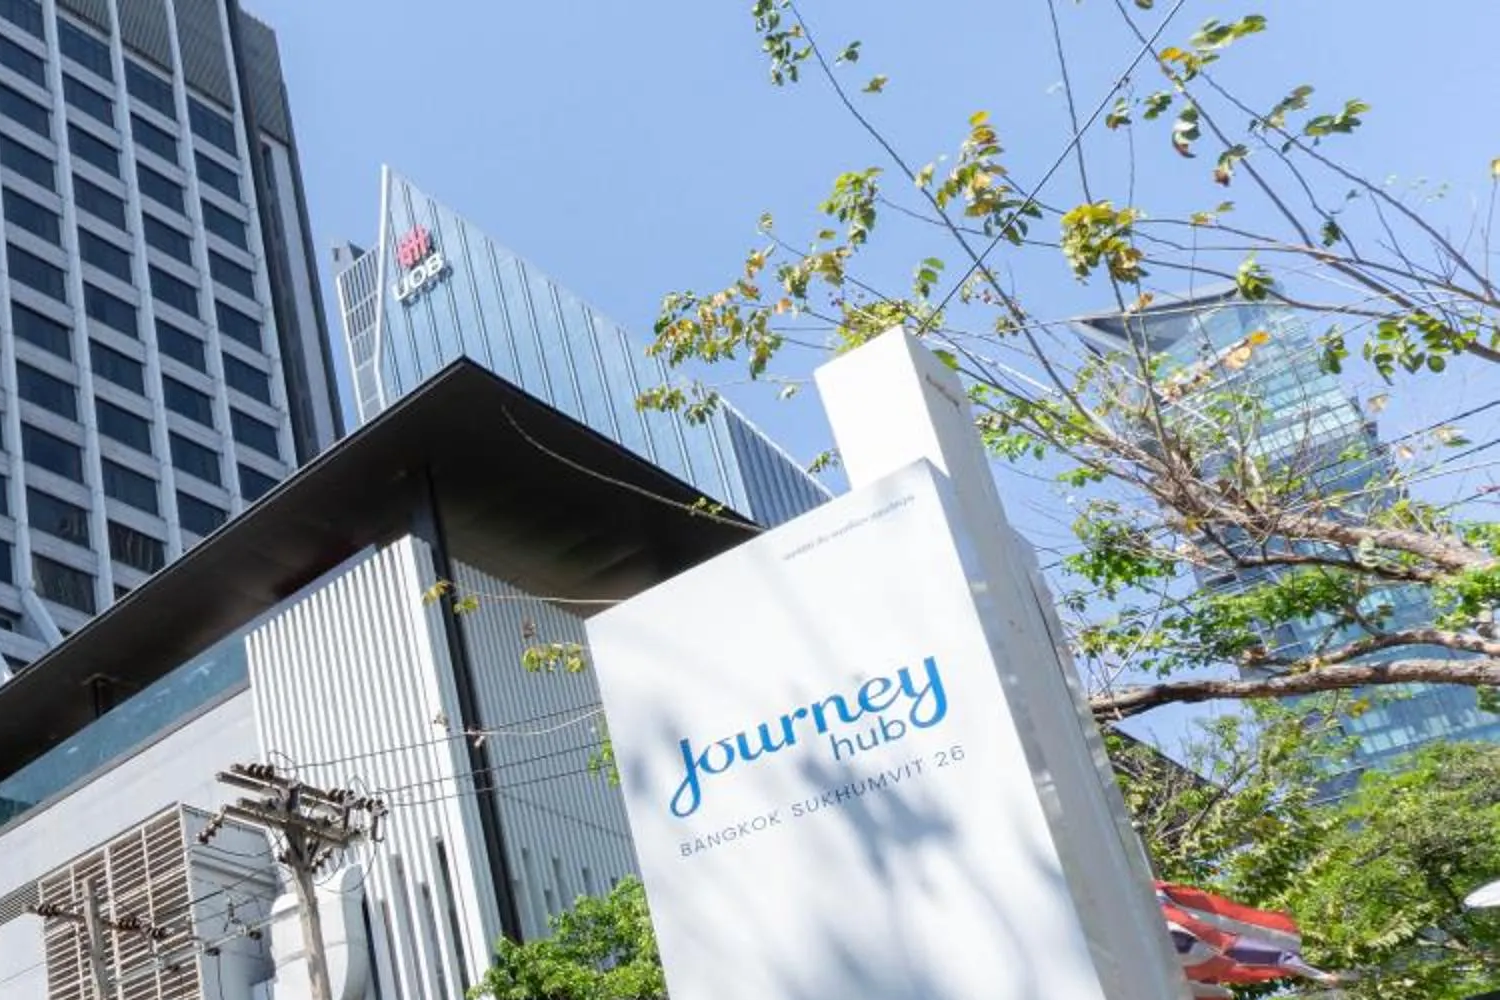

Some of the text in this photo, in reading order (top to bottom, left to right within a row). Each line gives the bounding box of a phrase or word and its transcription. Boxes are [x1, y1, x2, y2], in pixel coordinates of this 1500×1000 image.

[391, 251, 444, 302] UOB
[829, 715, 906, 761] hub
[679, 744, 966, 857] BANGKOK SUKHUMVIT 26
